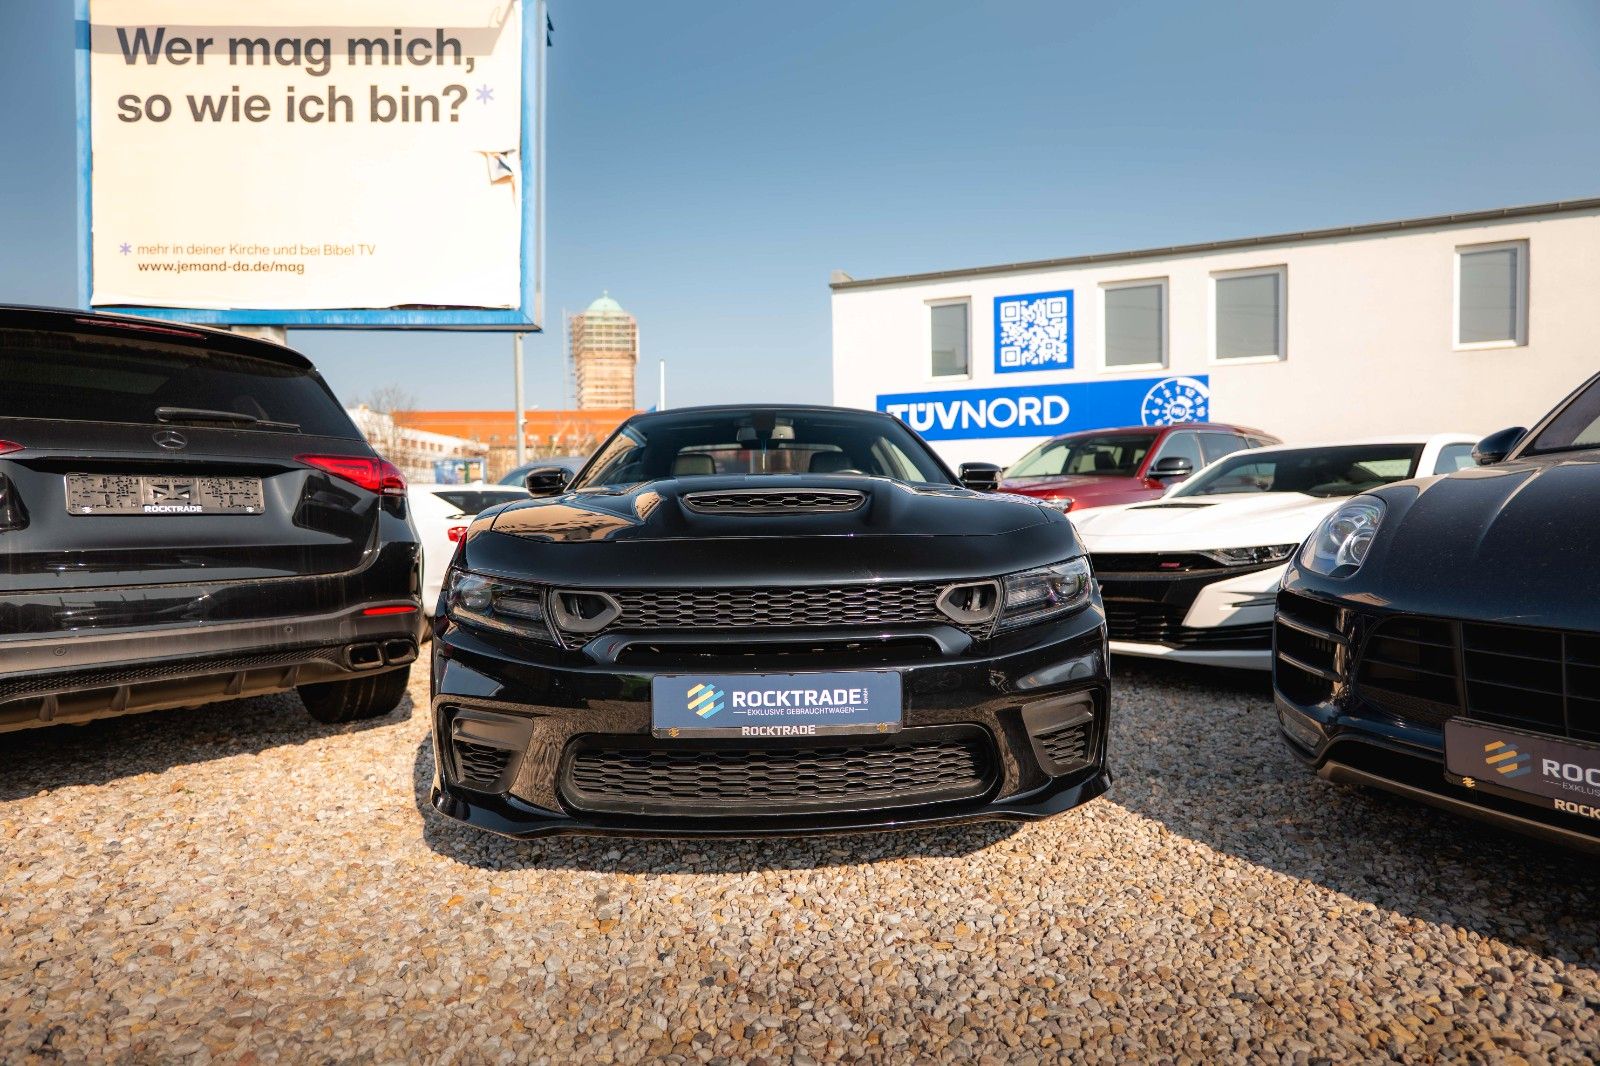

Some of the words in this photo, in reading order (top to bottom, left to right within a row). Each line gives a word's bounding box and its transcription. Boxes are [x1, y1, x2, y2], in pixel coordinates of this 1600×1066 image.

[116, 26, 213, 66] Wer
[228, 34, 331, 76] mag
[347, 27, 475, 74] mich,
[117, 92, 172, 123] so
[187, 85, 271, 123] wie
[286, 85, 354, 123] ich
[137, 244, 169, 255] mehr
[172, 244, 184, 255] in
[186, 244, 226, 255] deiner
[229, 244, 270, 255] Kirche
[273, 244, 297, 255] und
[300, 244, 321, 255] bei
[323, 244, 355, 256] Bibel
[357, 244, 376, 256] TV
[138, 261, 305, 274] www.jemand-da.de/mag
[732, 689, 861, 707] ROCKTRADE
[786, 707, 855, 716] GEBRAUCHTWAGEN
[741, 725, 816, 736] ROCKTRADE
